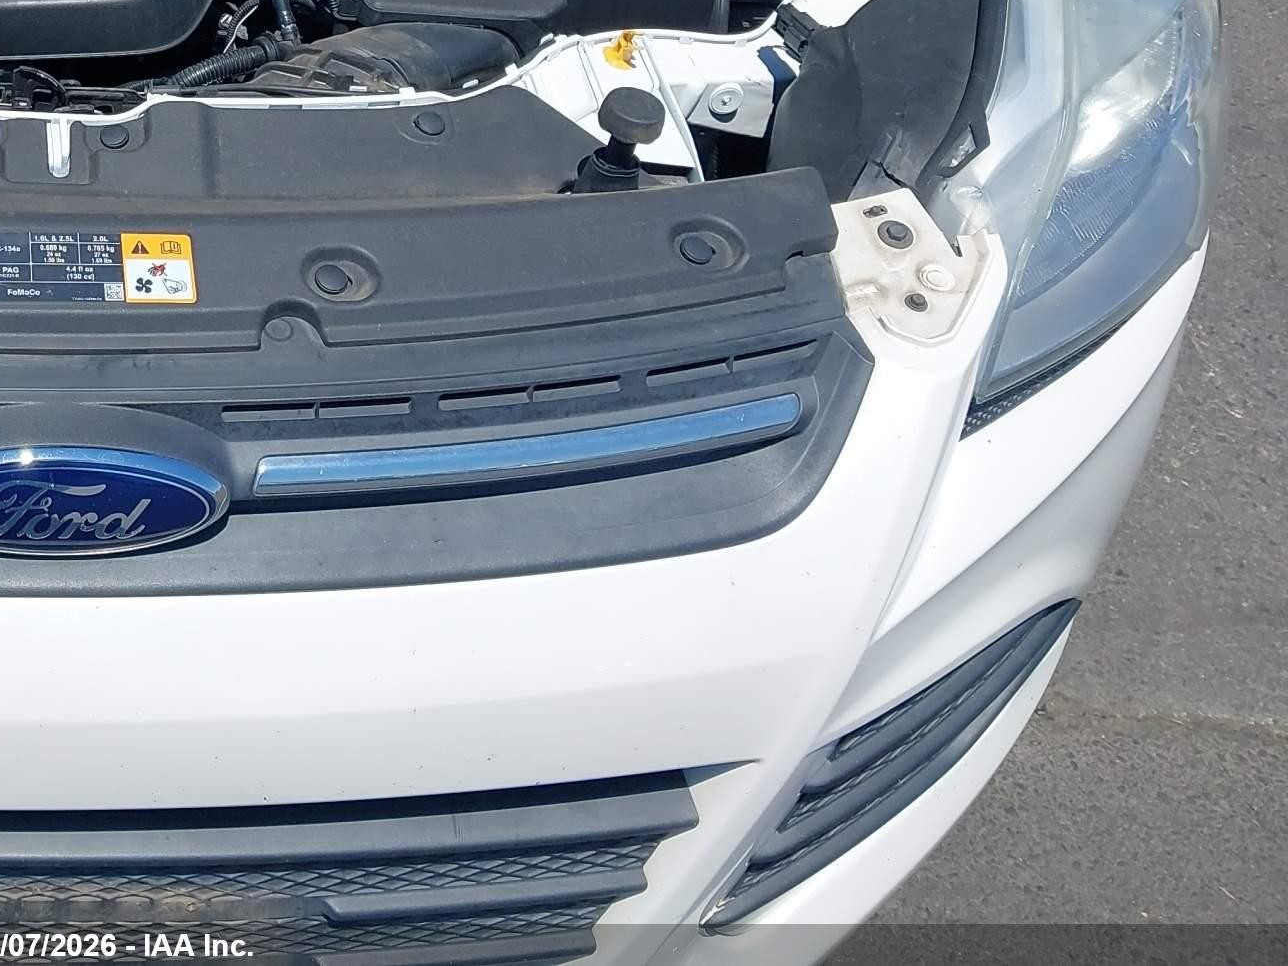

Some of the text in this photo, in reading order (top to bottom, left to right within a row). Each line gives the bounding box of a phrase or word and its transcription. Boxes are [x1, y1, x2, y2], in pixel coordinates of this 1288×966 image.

[2, 266, 20, 274] PAG
[66, 273, 82, 281] (130
[7, 288, 41, 296] FoMoCo
